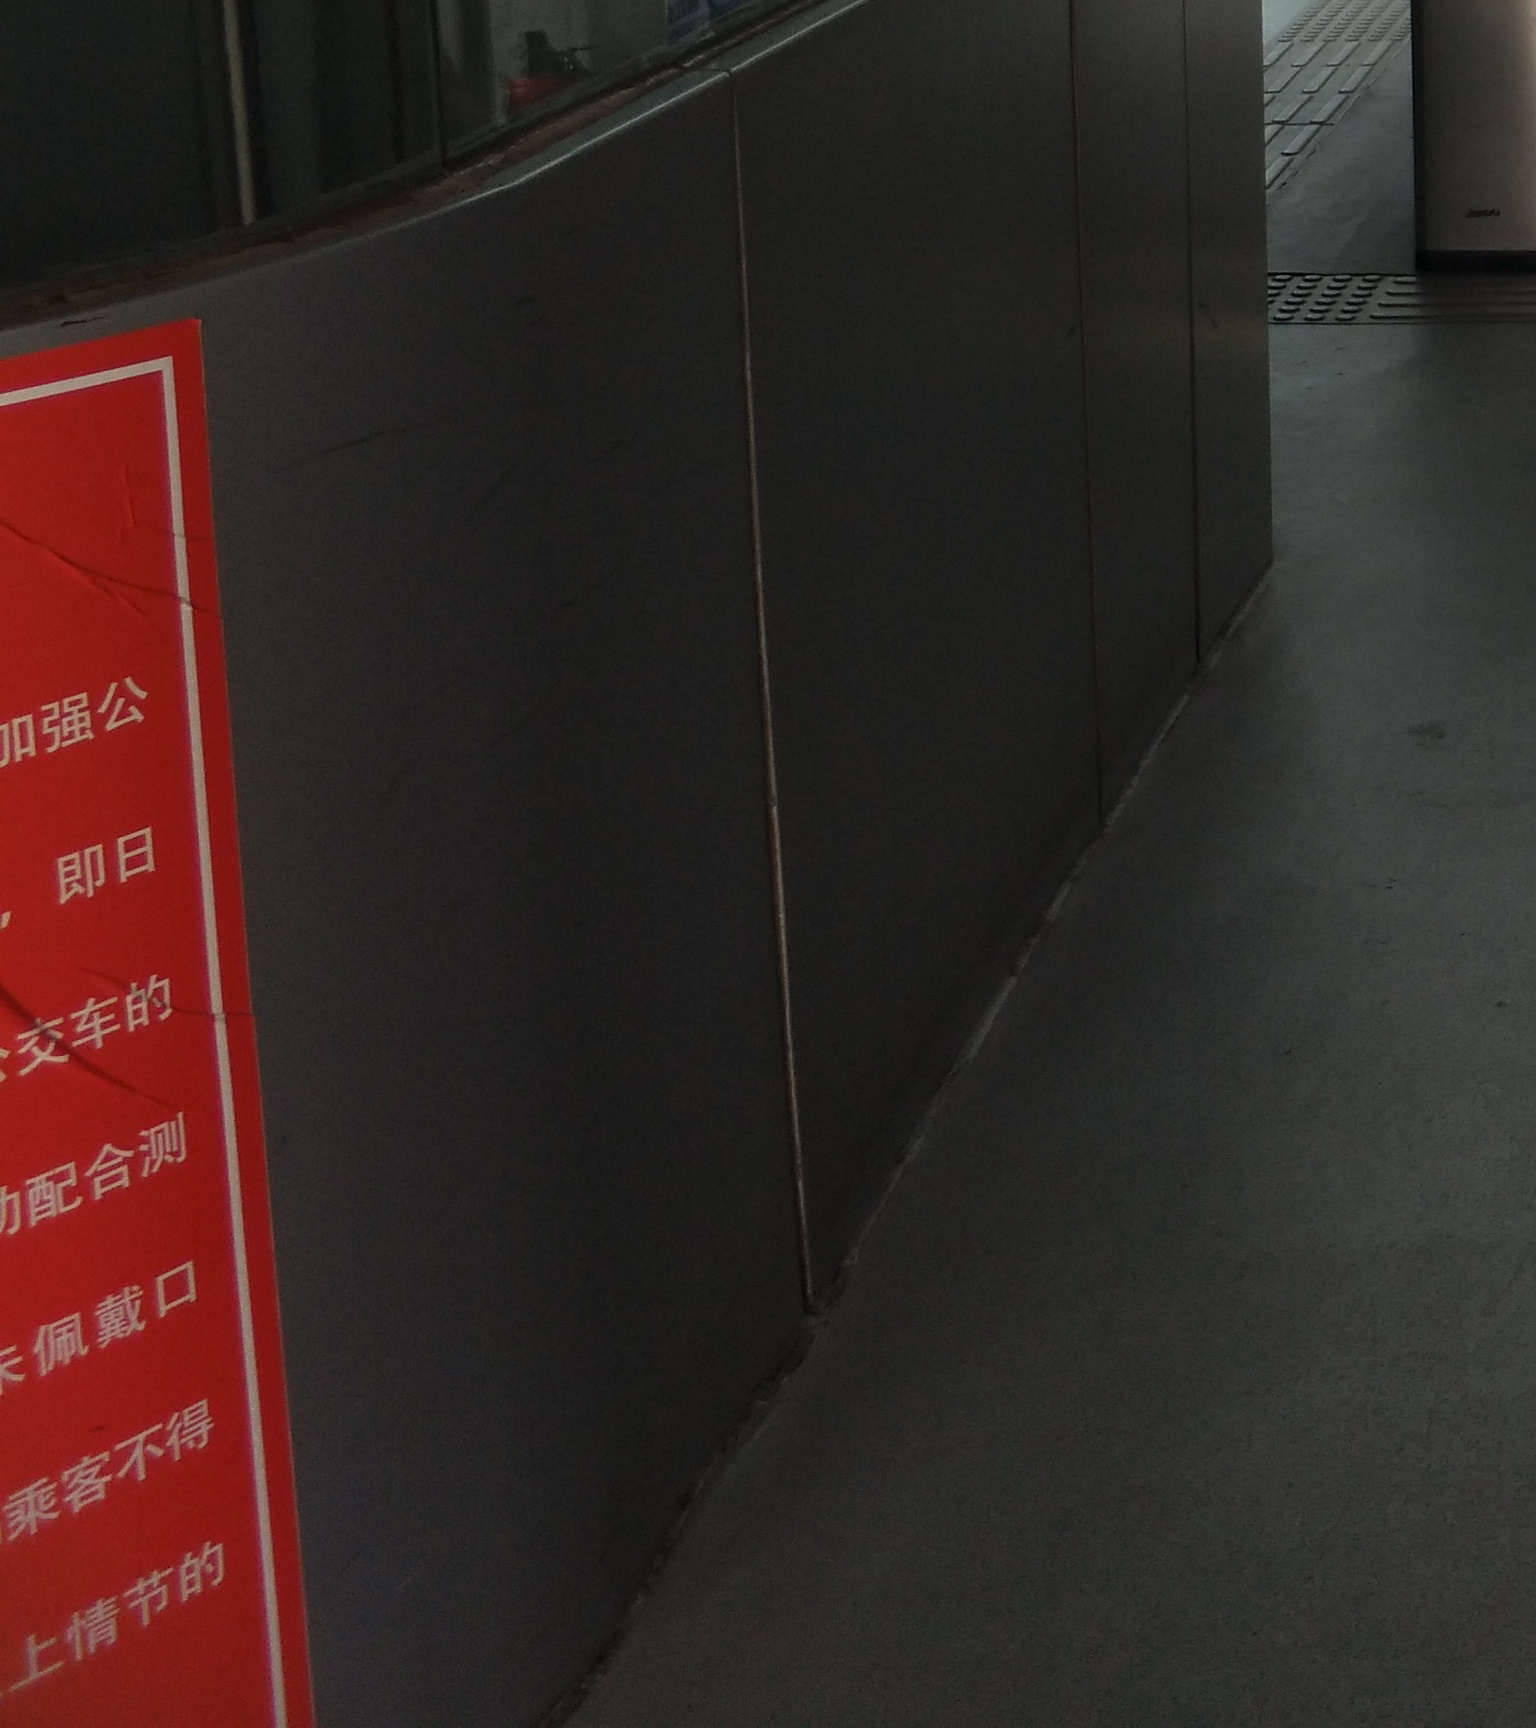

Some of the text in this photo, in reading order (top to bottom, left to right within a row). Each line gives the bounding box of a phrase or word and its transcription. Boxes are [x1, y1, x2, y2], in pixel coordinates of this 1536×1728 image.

[0, 973, 174, 1081] 交车的
[2, 1398, 214, 1541] 乘客不得
[8, 1541, 225, 1692] 上情节的
